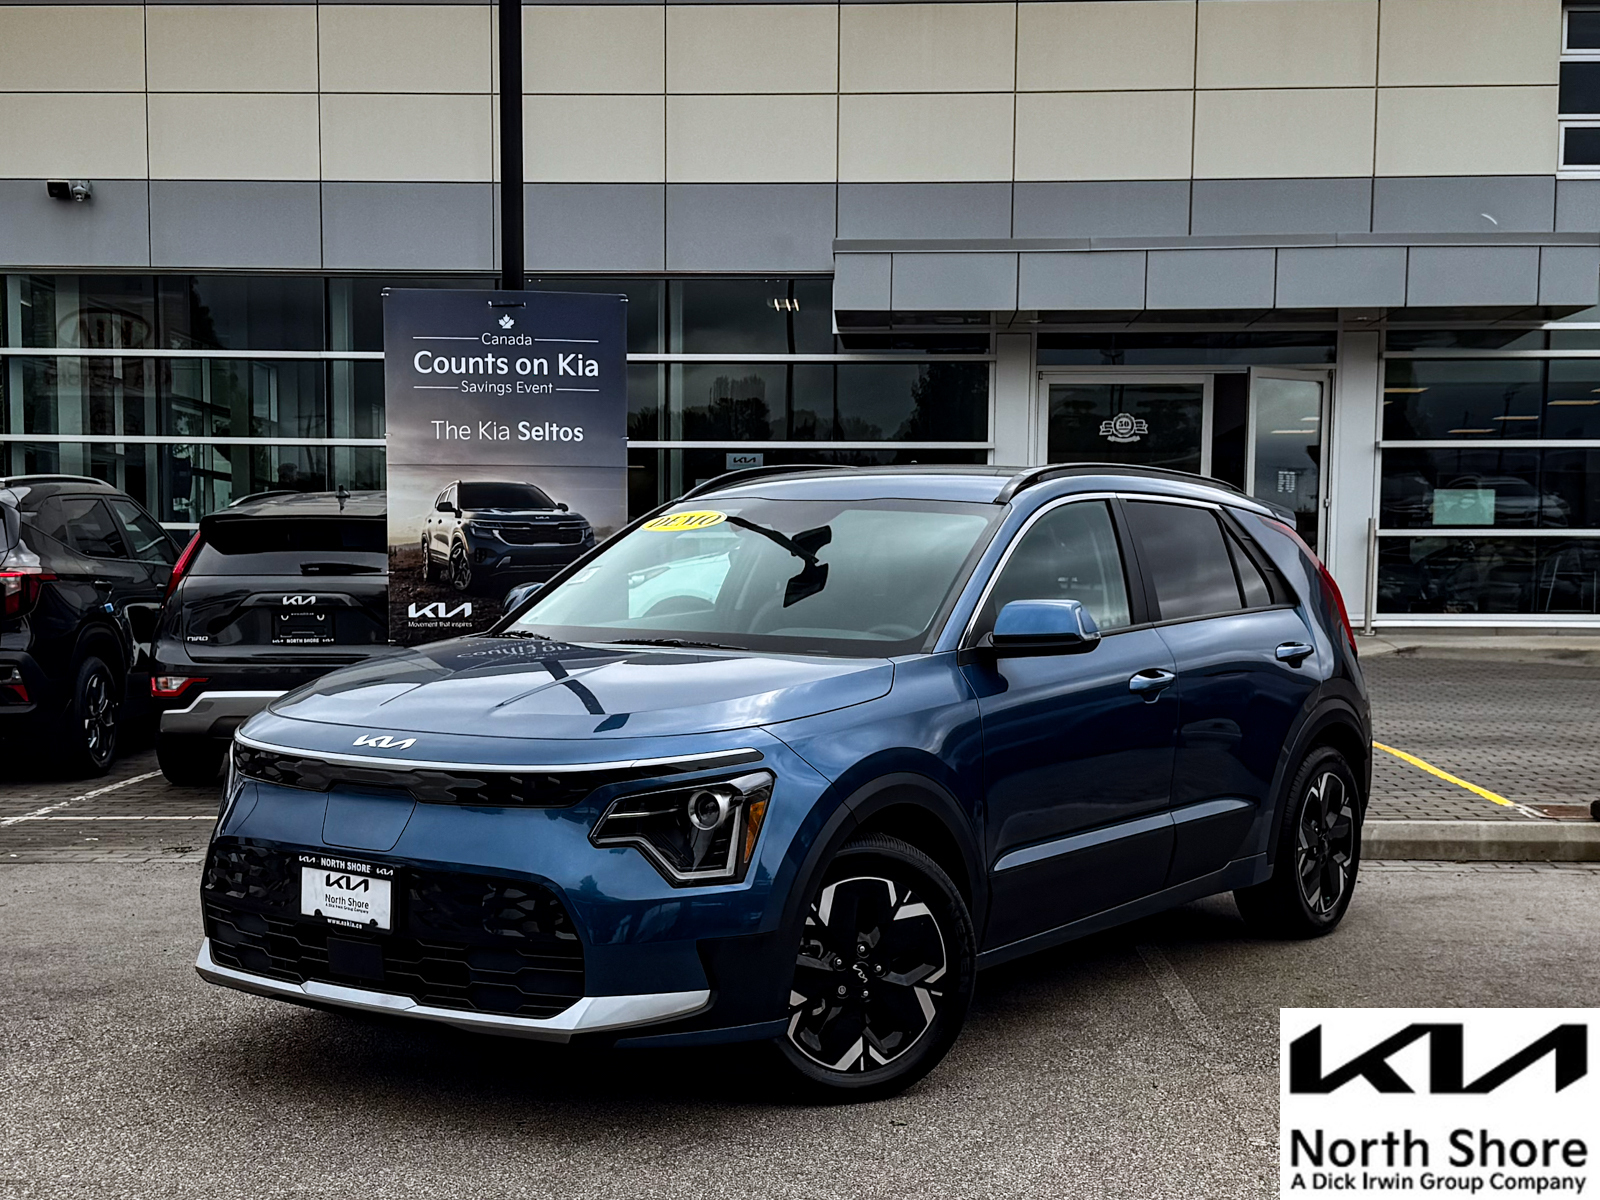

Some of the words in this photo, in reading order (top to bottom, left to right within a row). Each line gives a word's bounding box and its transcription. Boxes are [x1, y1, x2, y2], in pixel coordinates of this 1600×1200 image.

[481, 332, 533, 346] Canada
[413, 350, 509, 375] Counts
[515, 357, 549, 376] on
[557, 353, 600, 377] Kia
[461, 380, 513, 396] Savings
[516, 381, 553, 394] Event
[430, 420, 471, 440] The
[478, 420, 510, 441] Kia
[517, 420, 584, 442] Seltos
[647, 514, 722, 529] DEMO
[282, 595, 316, 605] KIA
[408, 602, 473, 618] KIA
[353, 734, 417, 750] KIA
[321, 858, 345, 869] NORTH
[347, 862, 371, 873] SHORE
[325, 873, 370, 893] KIA
[325, 893, 346, 905] North
[347, 897, 369, 910] Shore
